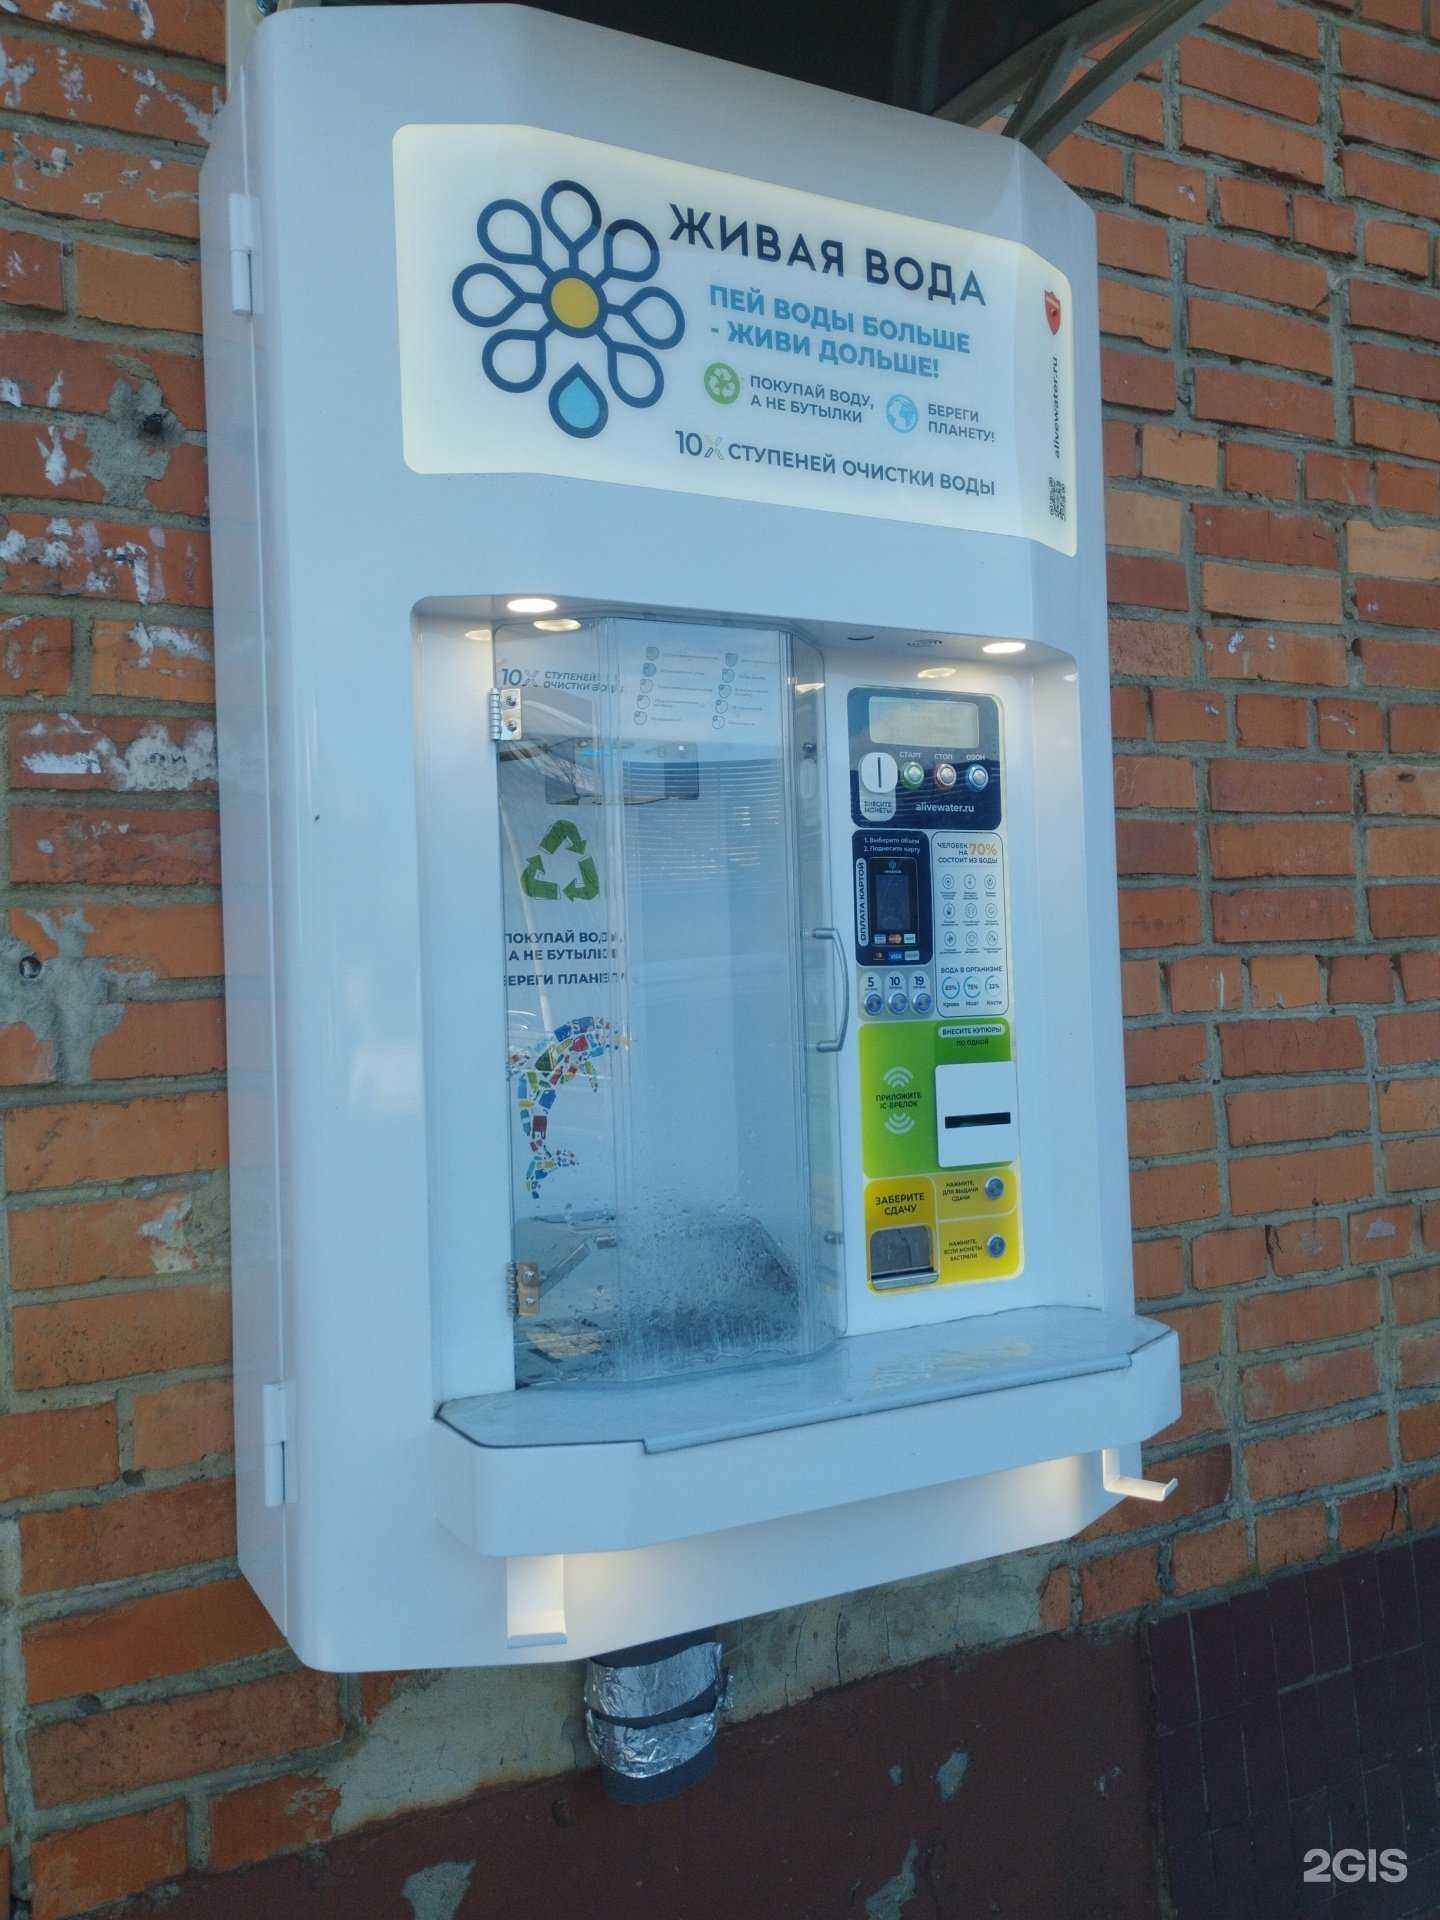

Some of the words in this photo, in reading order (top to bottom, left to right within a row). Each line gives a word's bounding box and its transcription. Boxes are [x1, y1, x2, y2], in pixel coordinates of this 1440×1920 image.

[669, 203, 844, 277] ЖИВАЯ
[865, 247, 987, 306] ВОДА
[710, 284, 765, 312] ПЕЙ
[774, 293, 855, 333] ВОДЫ
[862, 314, 970, 354] БОЛЬШЕ
[728, 320, 811, 355] ЖИВИ
[818, 338, 939, 378] ДОЛЬШЕ!
[750, 375, 825, 399] ПОКУПАЙ
[830, 388, 874, 410] ВОДУ,
[750, 394, 762, 407] А
[766, 396, 786, 411] НЕ
[791, 401, 862, 423] БУТЫЛКИ
[928, 402, 979, 423] БЕРЕГИ
[1052, 356, 1061, 459] alivewater.ru
[928, 420, 995, 442] ПЛАНЕТУ!
[728, 443, 836, 474] СТУПЕНЕЙ
[842, 460, 934, 488] ОЧИСТКИ
[940, 473, 995, 496] ВОДЫ
[915, 801, 975, 813] alivewater.ru
[969, 843, 998, 855] 70%
[857, 862, 866, 899] КАРТОЙ
[509, 950, 519, 960] А
[524, 949, 542, 960] НЕ
[504, 974, 553, 986] ЕРЕГИ
[868, 976, 874, 987] 5
[890, 976, 900, 986] 10
[914, 976, 924, 985] 19
[875, 1192, 925, 1206] ЗАБЕРИТЕ
[884, 1203, 917, 1216] СДАЧУ
